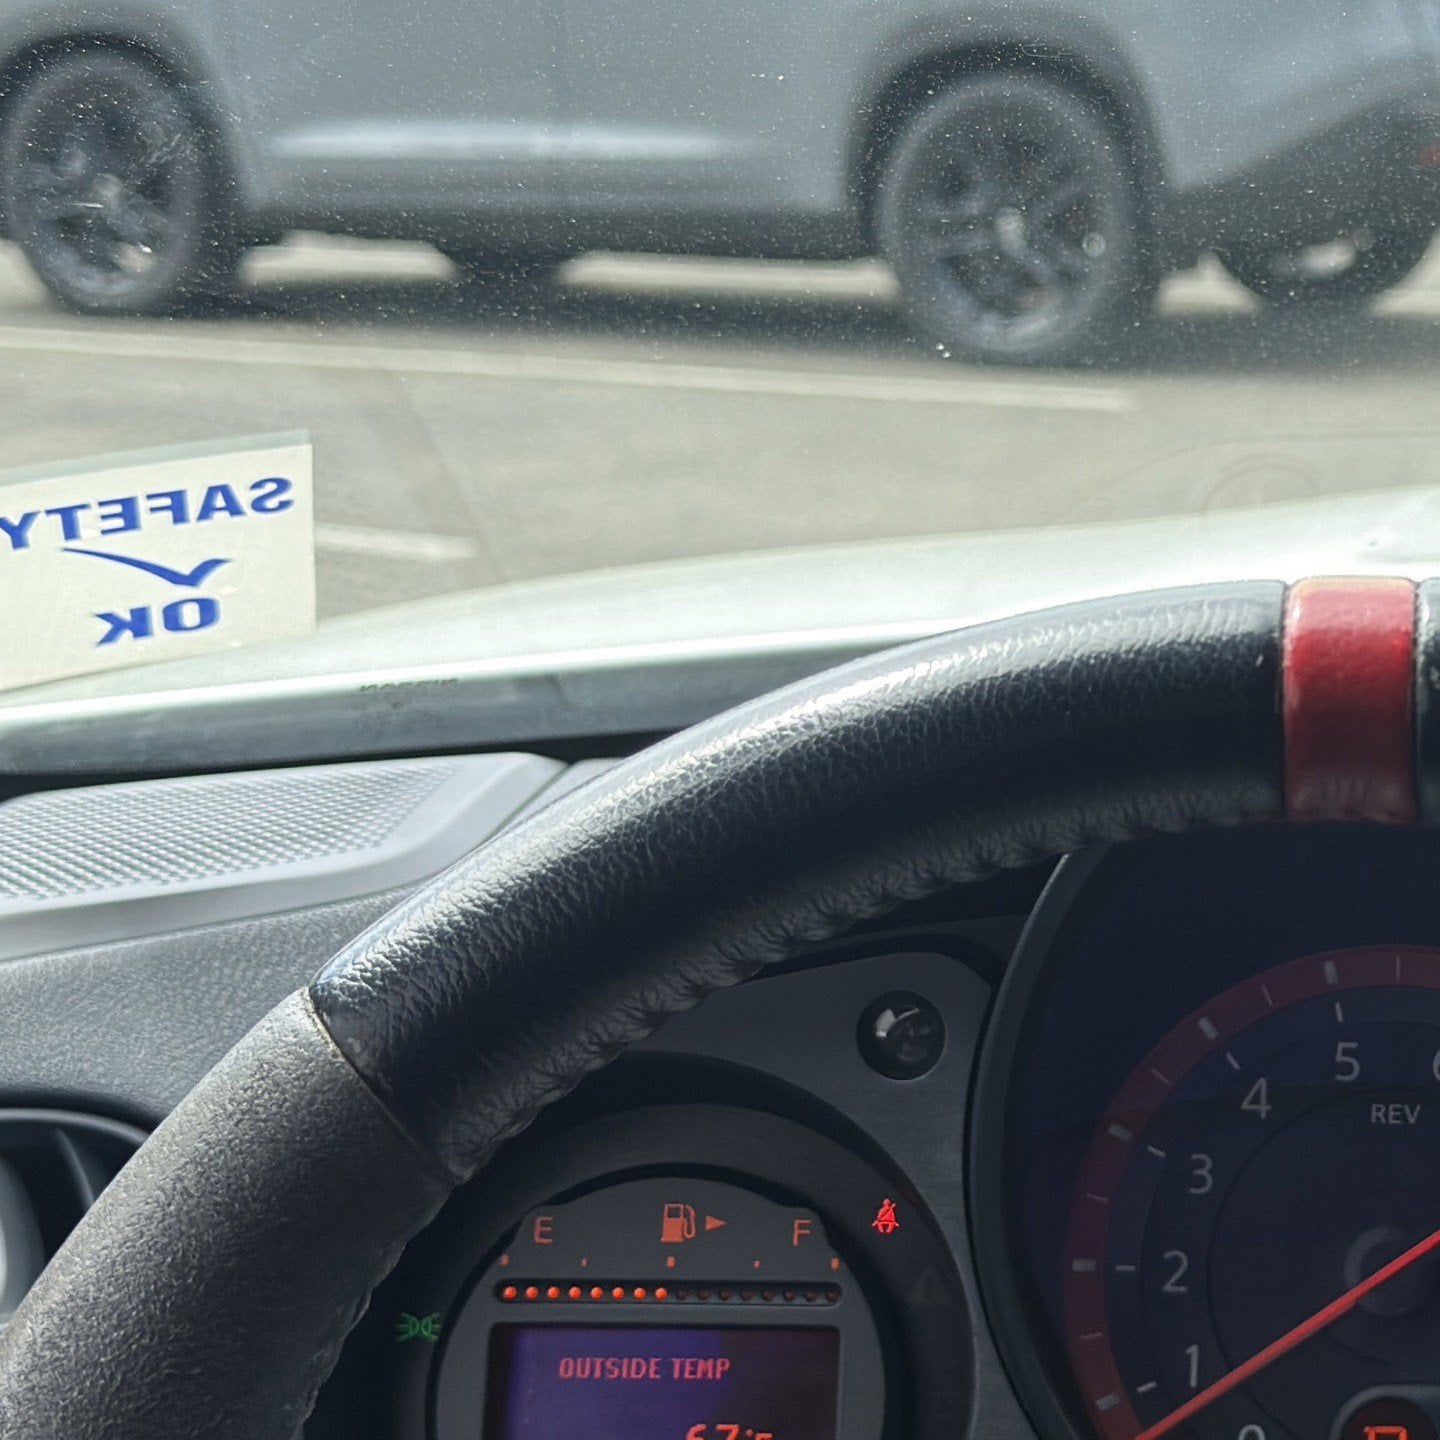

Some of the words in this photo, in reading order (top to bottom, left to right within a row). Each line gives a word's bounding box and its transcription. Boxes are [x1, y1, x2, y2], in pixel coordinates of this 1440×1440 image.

[1335, 1042, 1360, 1082] 5
[1241, 1078, 1272, 1119] 4
[1371, 1104, 1421, 1124] REV
[1188, 1153, 1213, 1194] 3
[534, 1216, 553, 1244] E
[792, 1220, 811, 1246] F
[1163, 1252, 1188, 1292] 2
[559, 1357, 661, 1380] OUTSIDE
[672, 1357, 730, 1380] TEMP
[1186, 1345, 1199, 1386] 1
